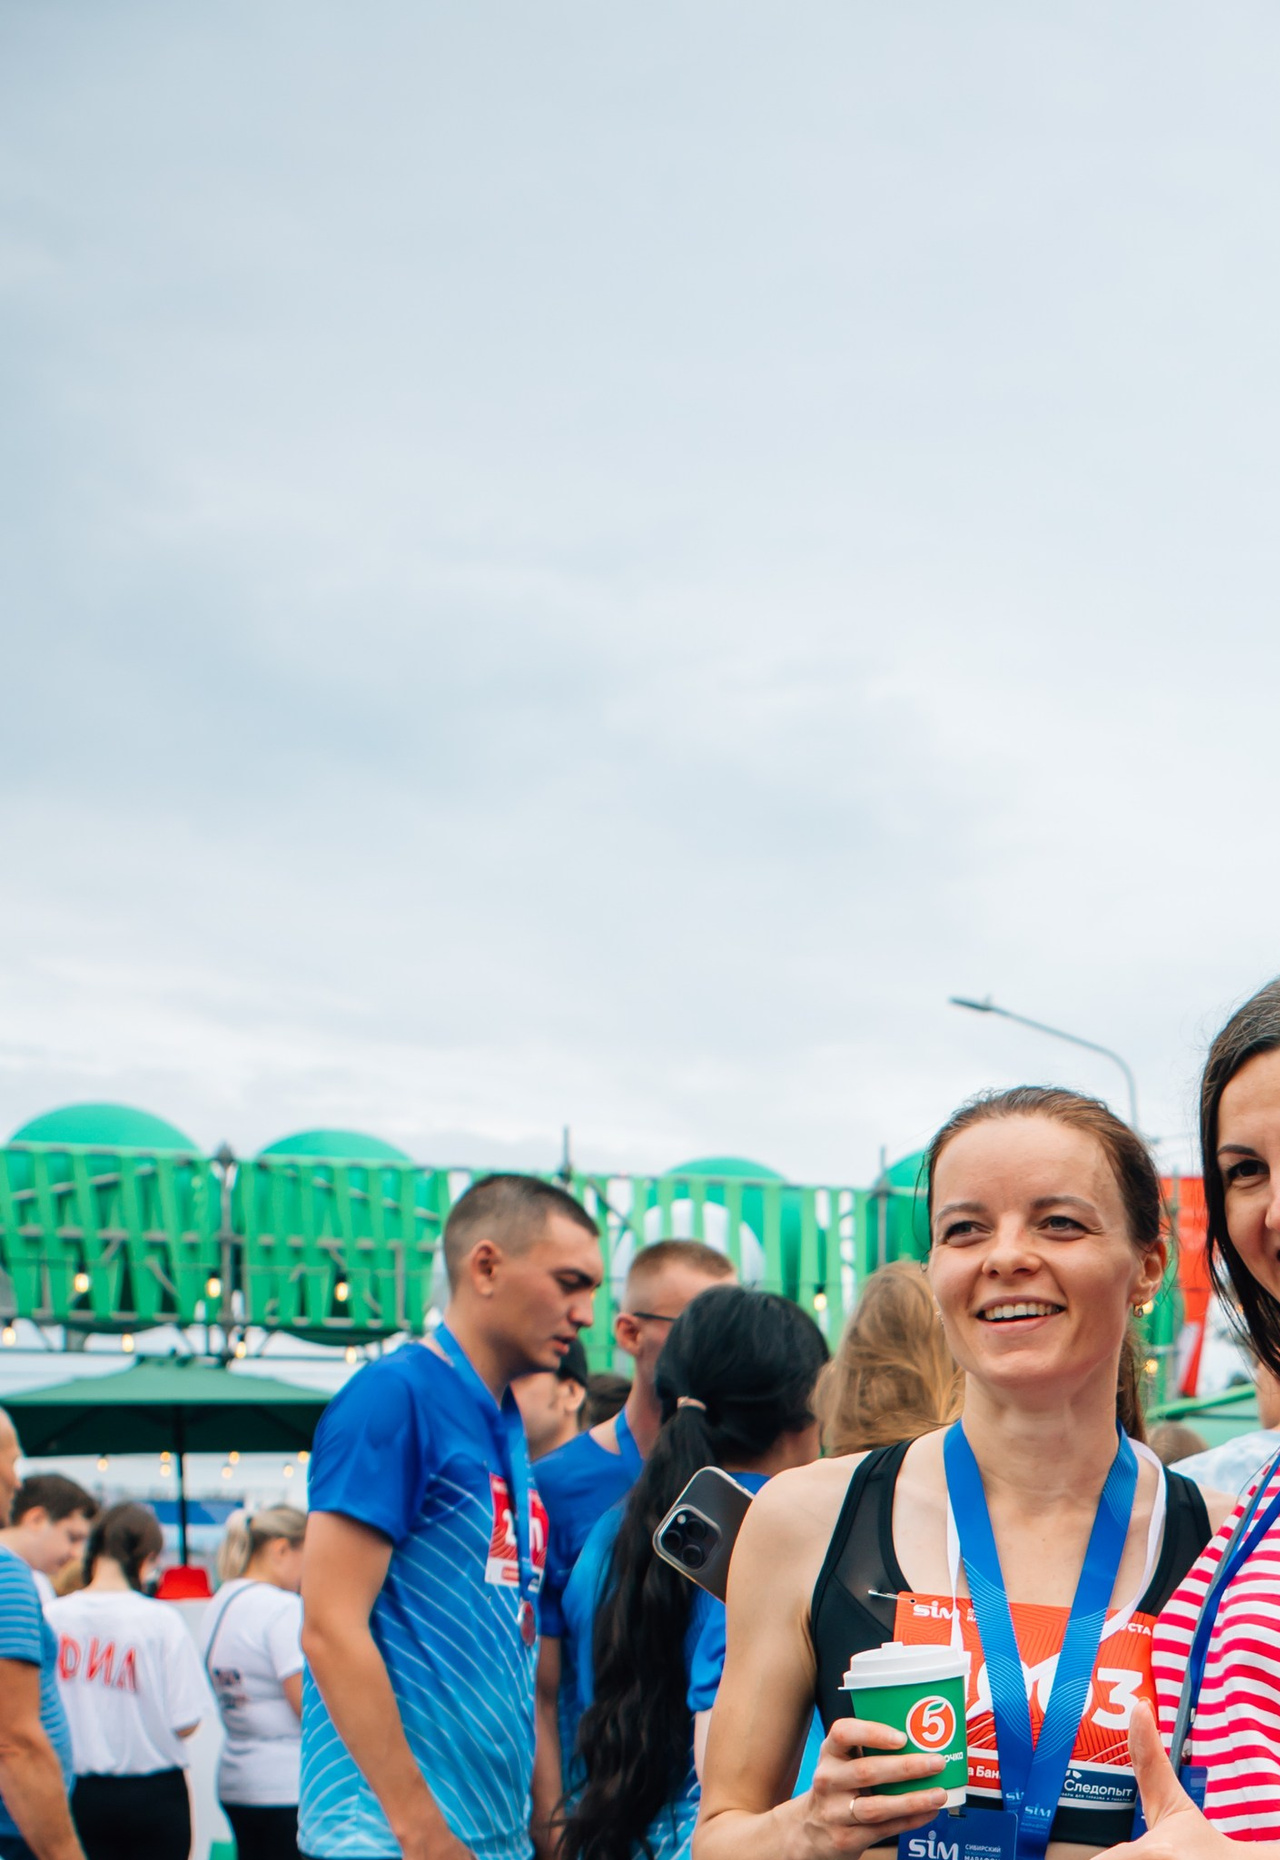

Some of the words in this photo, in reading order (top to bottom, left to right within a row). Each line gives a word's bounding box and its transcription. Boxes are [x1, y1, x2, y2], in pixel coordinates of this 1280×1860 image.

[921, 1699, 947, 1743] 5
[1063, 1779, 1133, 1798] Следопыт
[964, 1843, 1002, 1854] СИБИРСКИЙ
